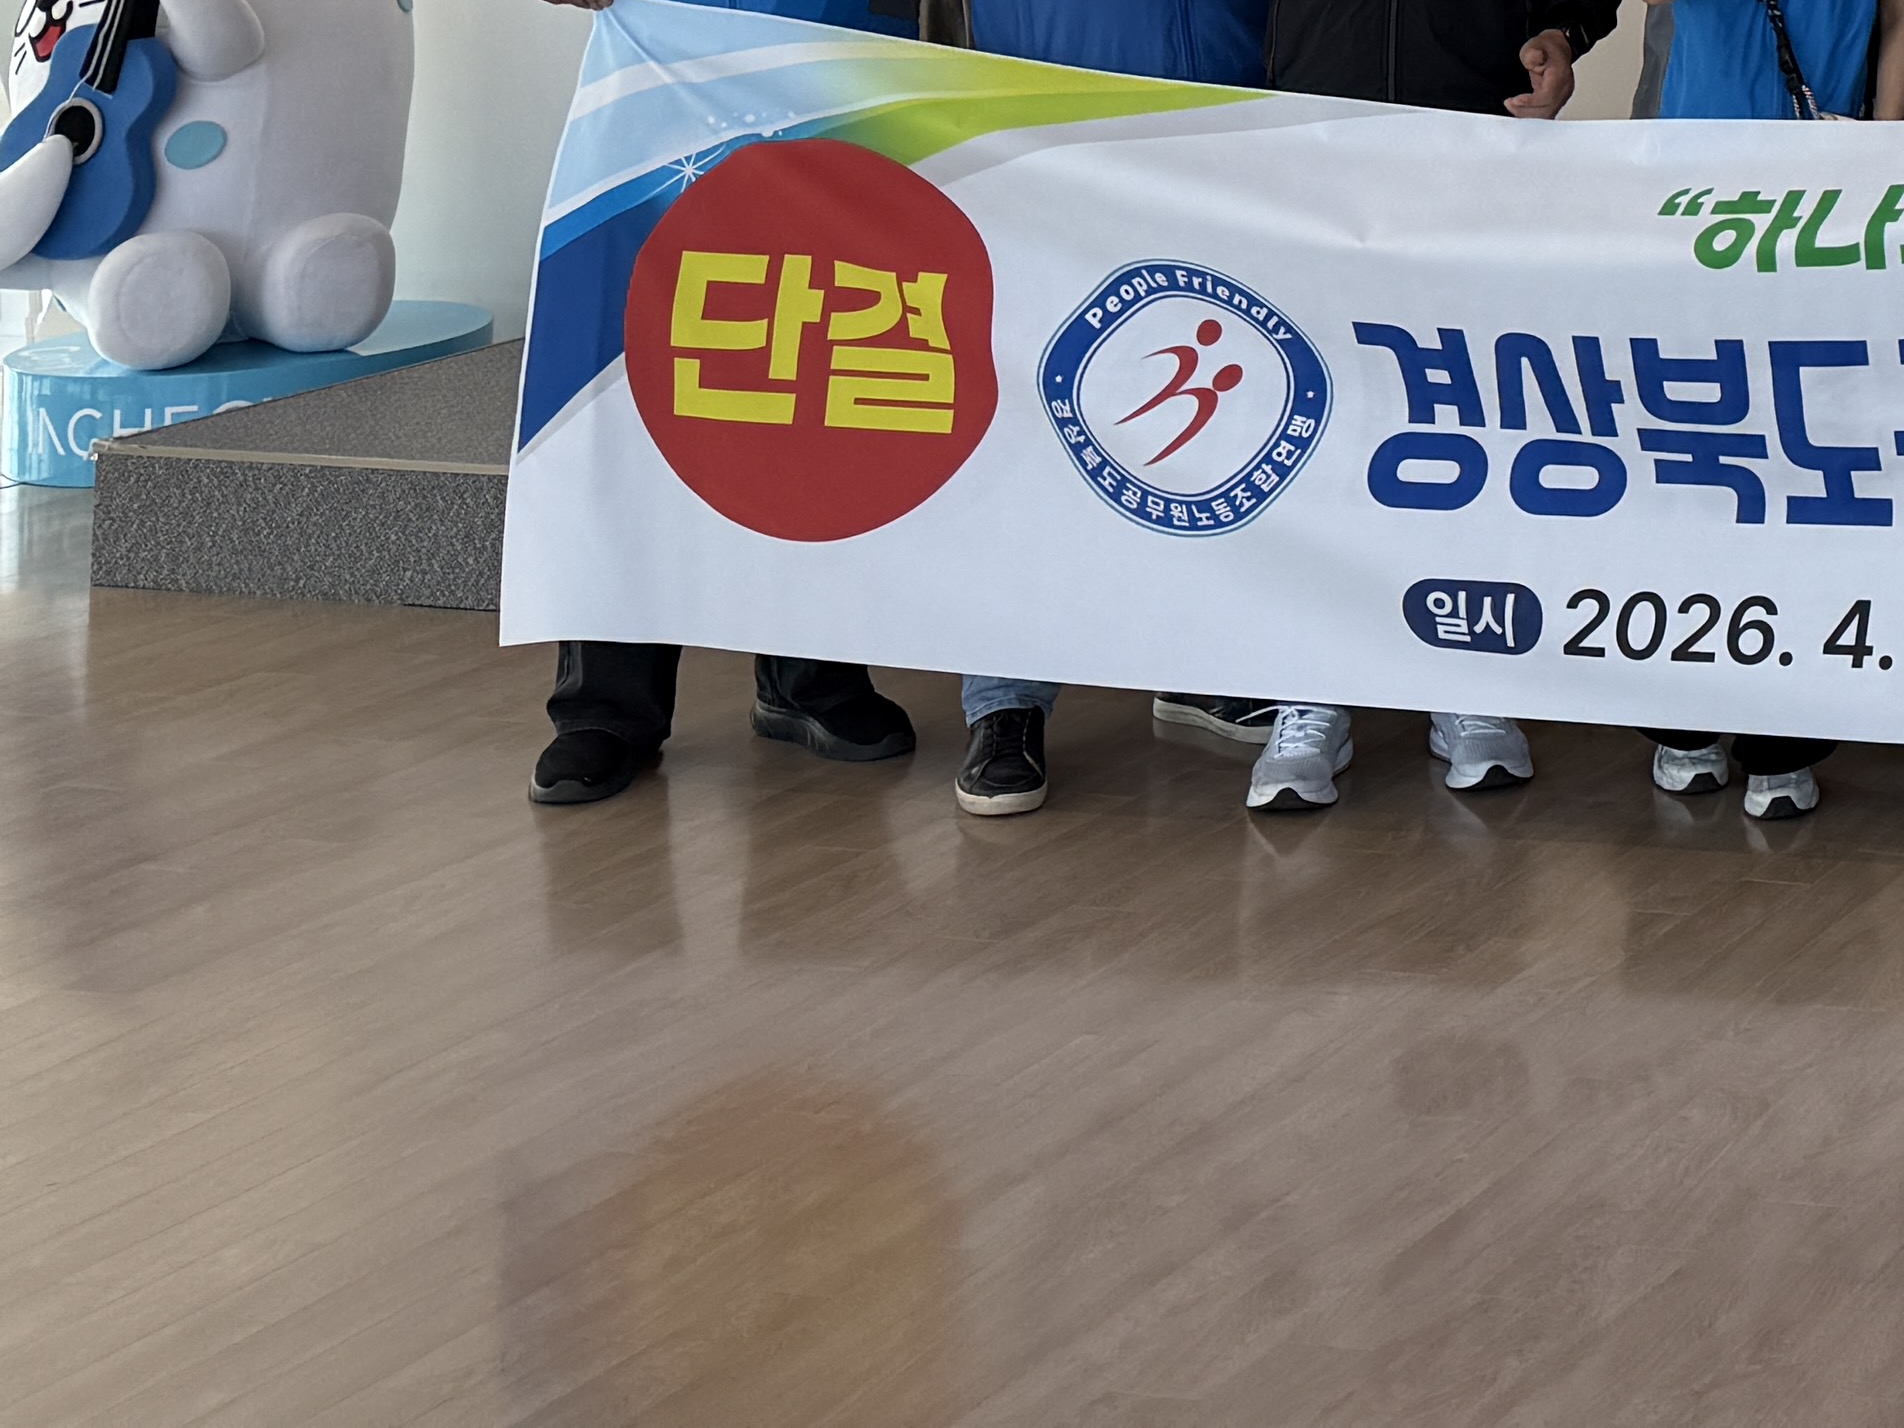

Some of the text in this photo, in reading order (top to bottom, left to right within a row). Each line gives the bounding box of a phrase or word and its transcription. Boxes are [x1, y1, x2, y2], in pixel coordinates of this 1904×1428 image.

[671, 251, 955, 433] 단결
[1084, 269, 1293, 342] People Friendly
[1051, 398, 1316, 528] 경상북도공무원노동조합연맹
[1424, 589, 1515, 649] 일시
[1562, 588, 1794, 667] 2026.
[1822, 599, 1894, 671] 4.
